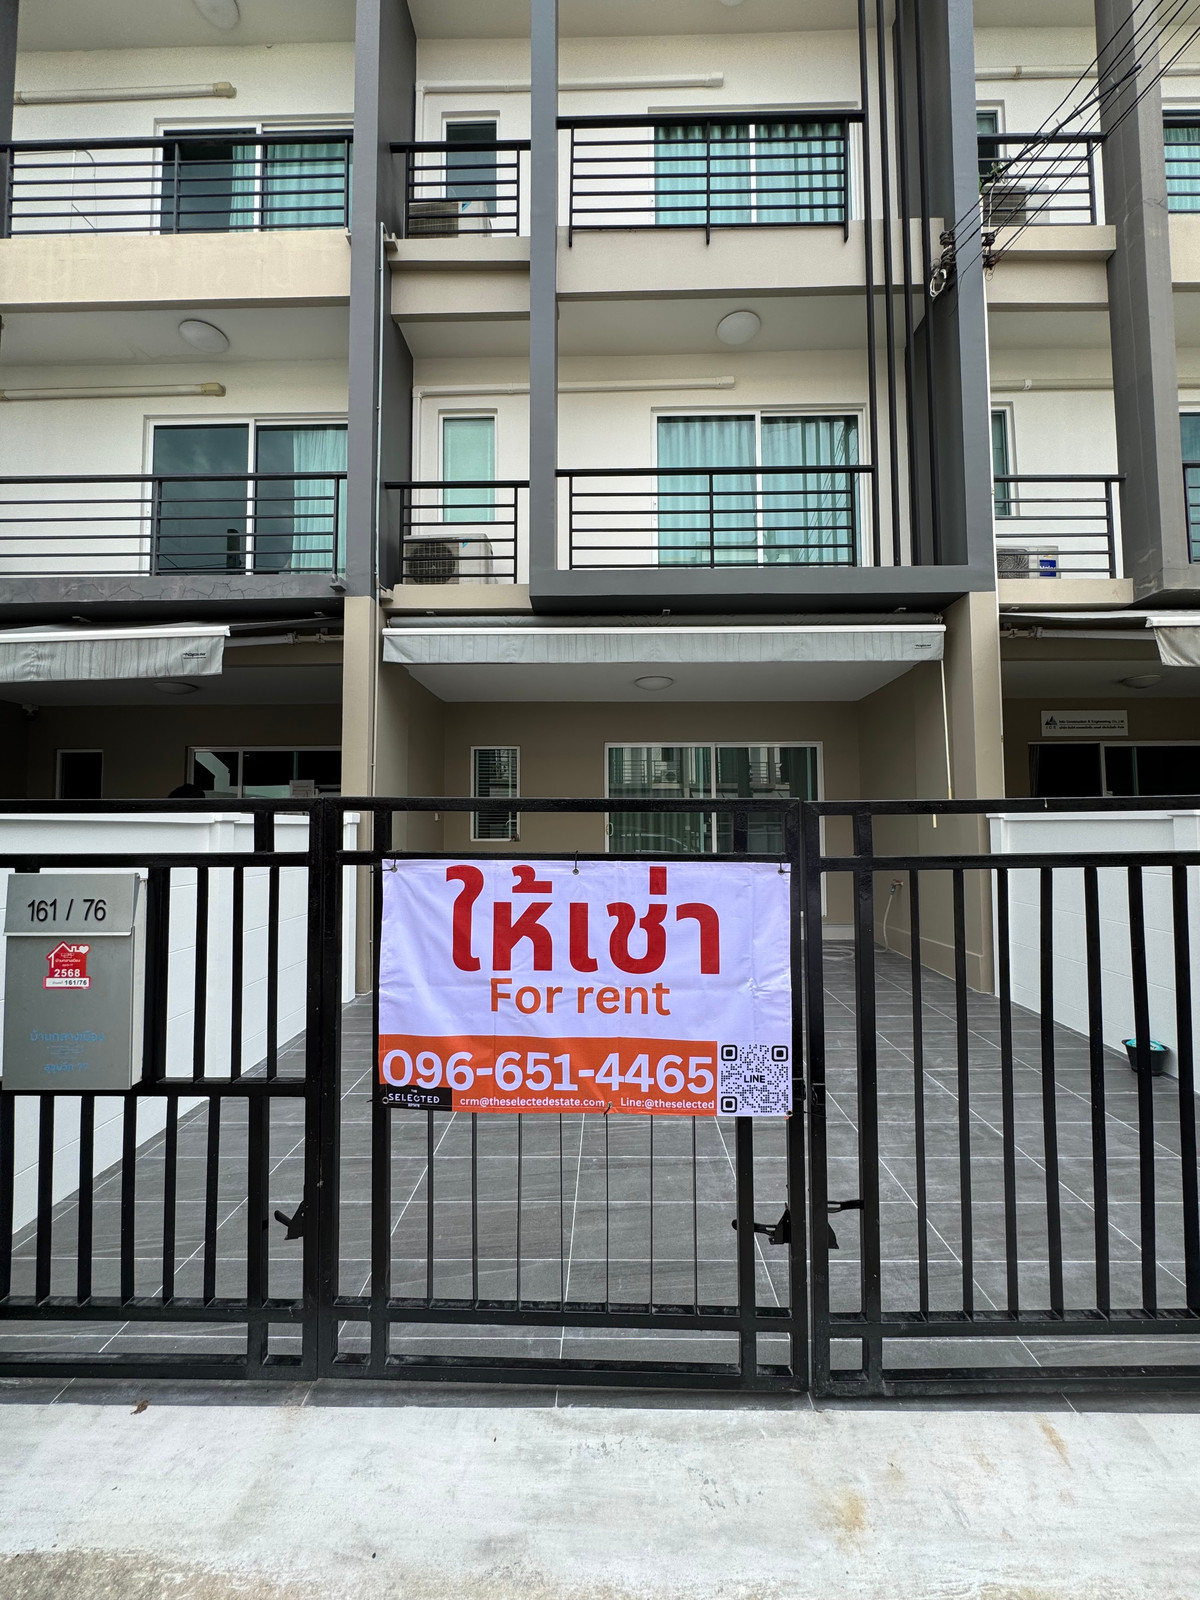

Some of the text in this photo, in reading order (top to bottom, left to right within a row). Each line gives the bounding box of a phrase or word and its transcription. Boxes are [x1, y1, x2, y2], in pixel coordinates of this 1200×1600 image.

[28, 898, 106, 922] 161 / 76
[446, 864, 720, 975] ให้เช่า
[54, 968, 80, 977] 2568
[490, 977, 670, 1016] For rent
[382, 1048, 714, 1094] 096-651-4465
[743, 1074, 765, 1084] LINE
[388, 1093, 440, 1104] SELECTED
[460, 1096, 715, 1109] crm@theselectedestate.com Line:@theselected
